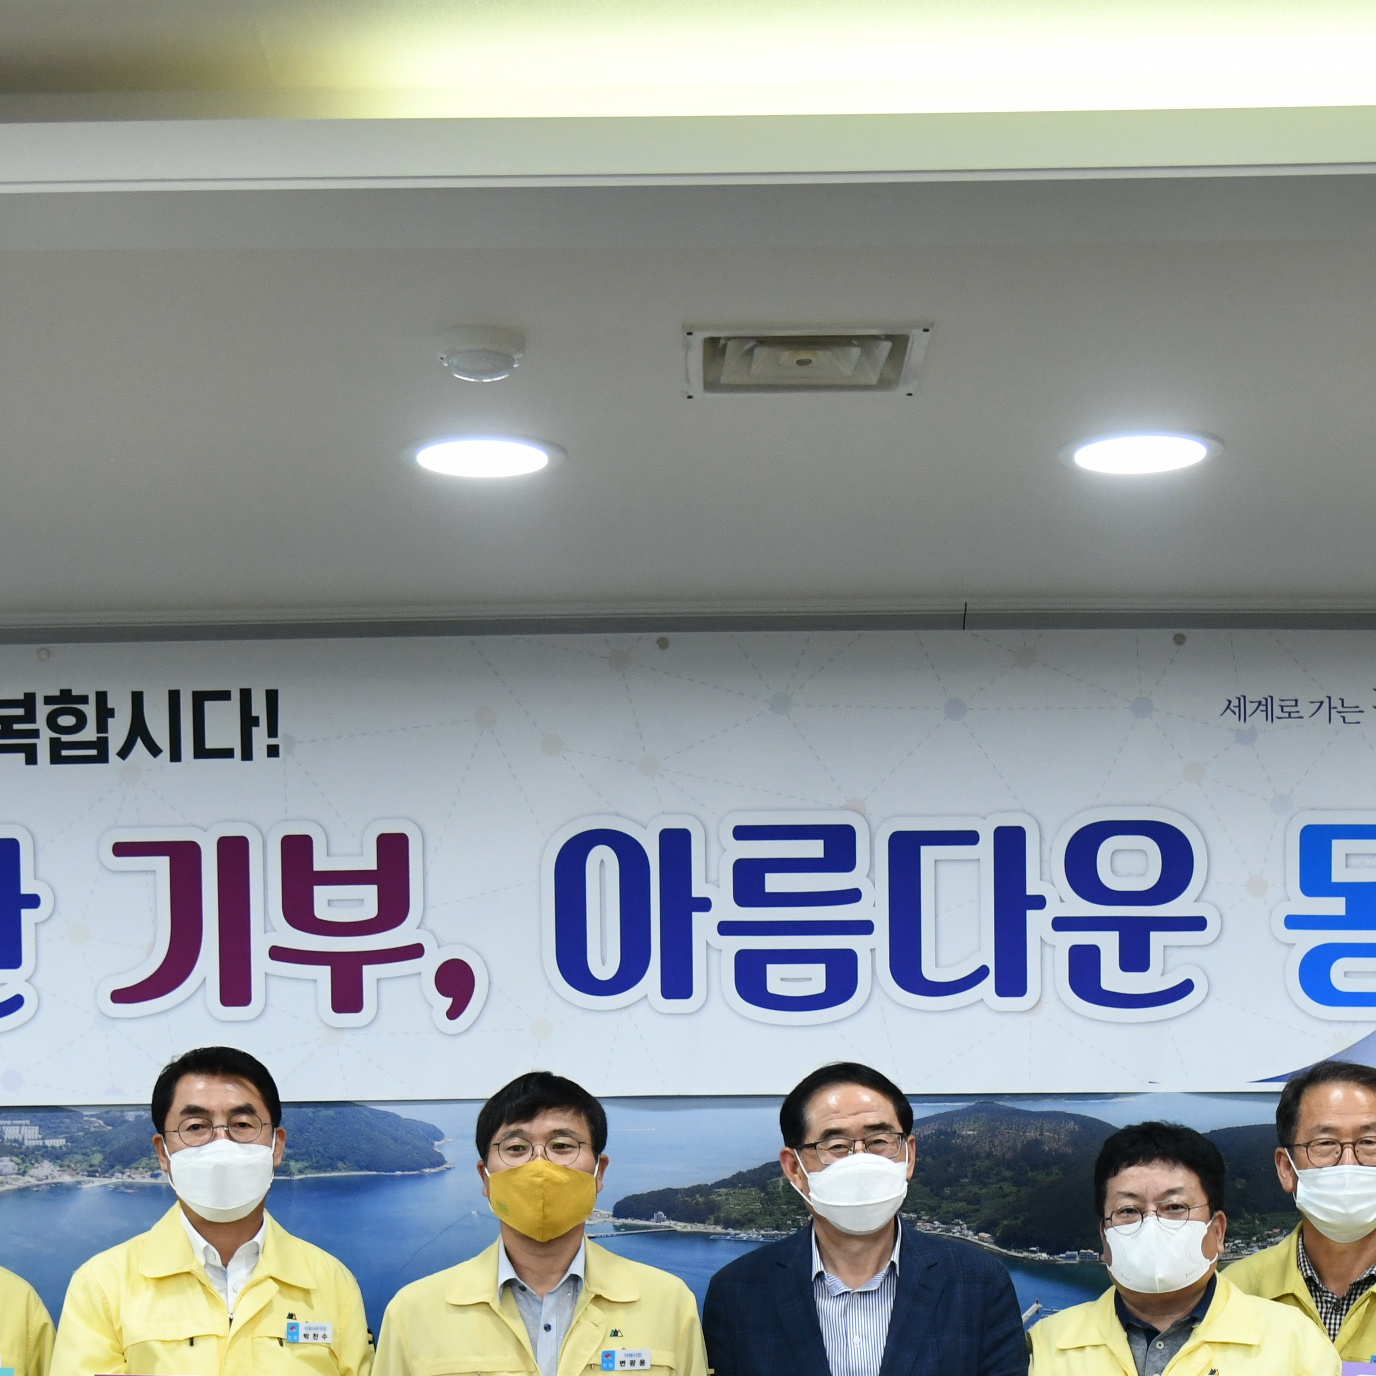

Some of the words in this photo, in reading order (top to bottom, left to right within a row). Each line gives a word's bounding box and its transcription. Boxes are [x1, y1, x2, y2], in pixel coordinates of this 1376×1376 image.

[1219, 694, 1305, 724] 세계로
[1308, 695, 1365, 725] 가는
[110, 833, 475, 1020] 기부,
[554, 820, 1207, 1012] 아름다운
